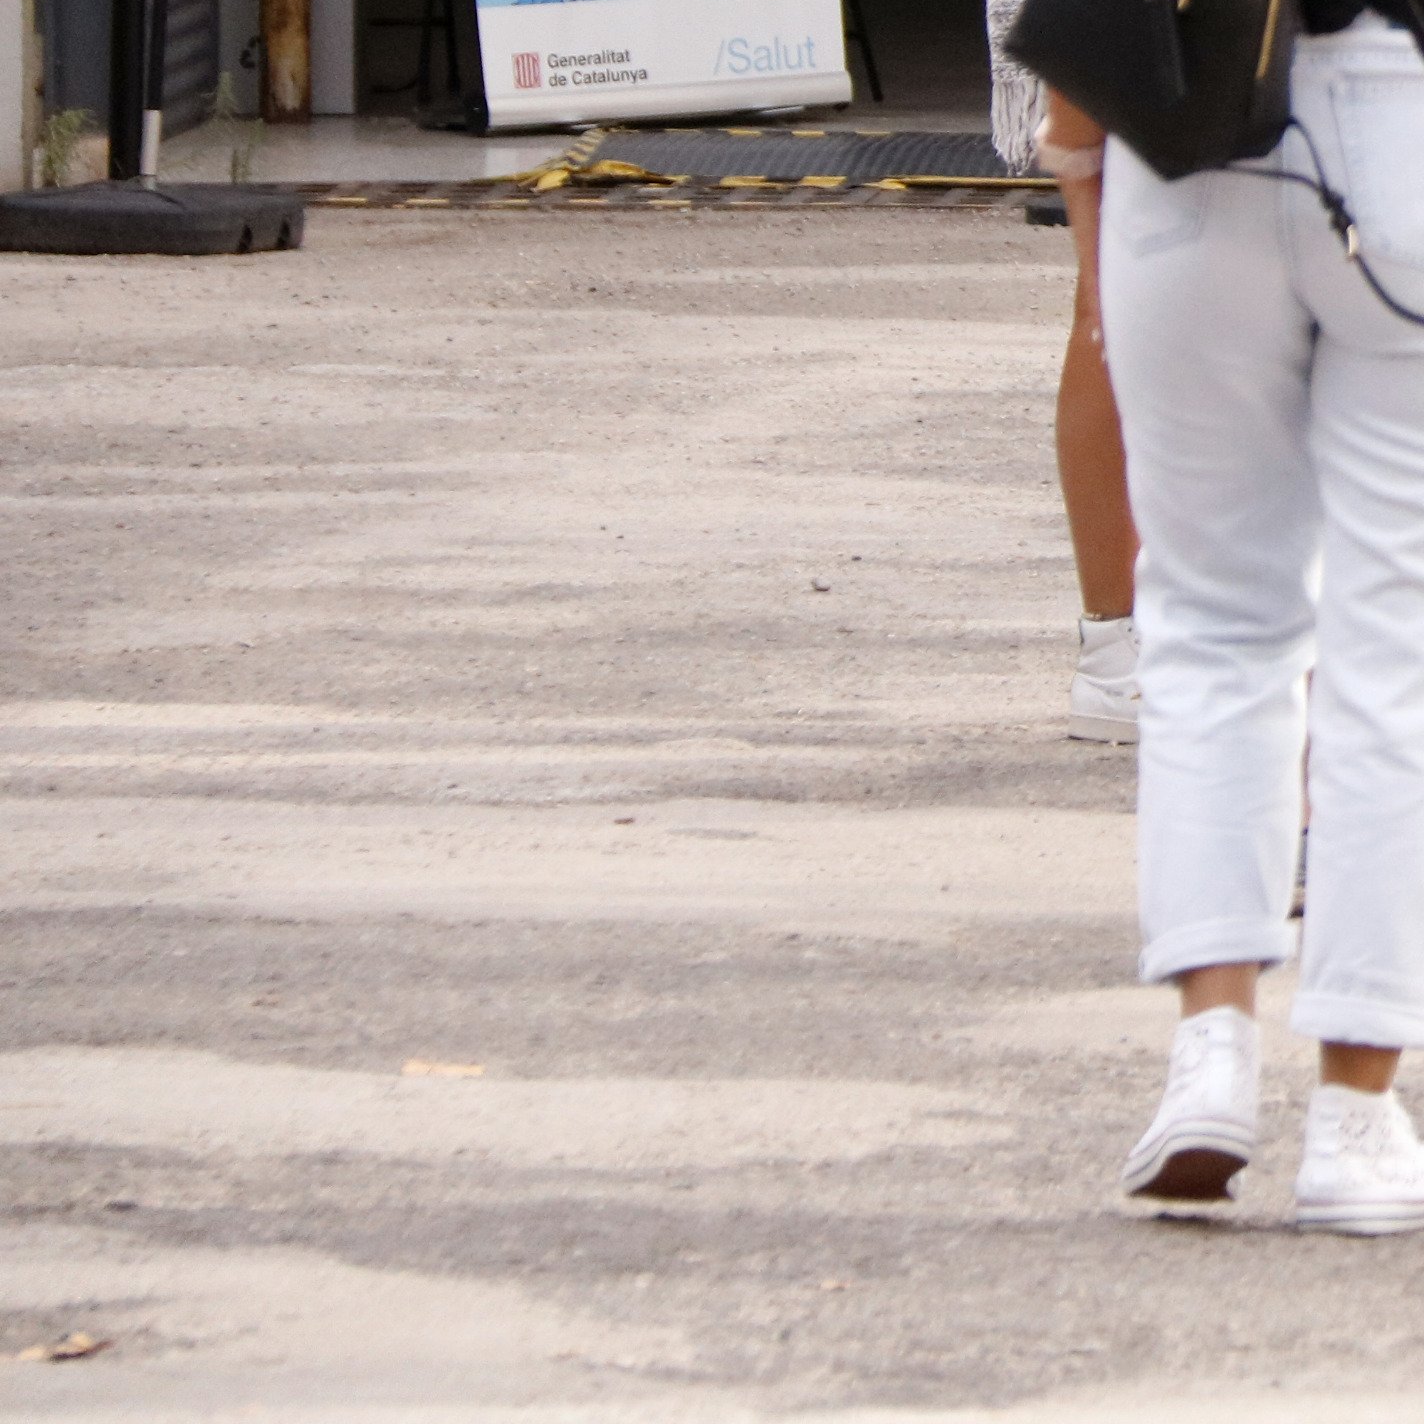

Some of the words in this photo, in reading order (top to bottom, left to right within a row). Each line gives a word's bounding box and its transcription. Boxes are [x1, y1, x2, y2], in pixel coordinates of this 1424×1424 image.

[547, 48, 631, 69] Generalitat
[548, 72, 567, 88] de
[571, 66, 648, 87] Catalunya
